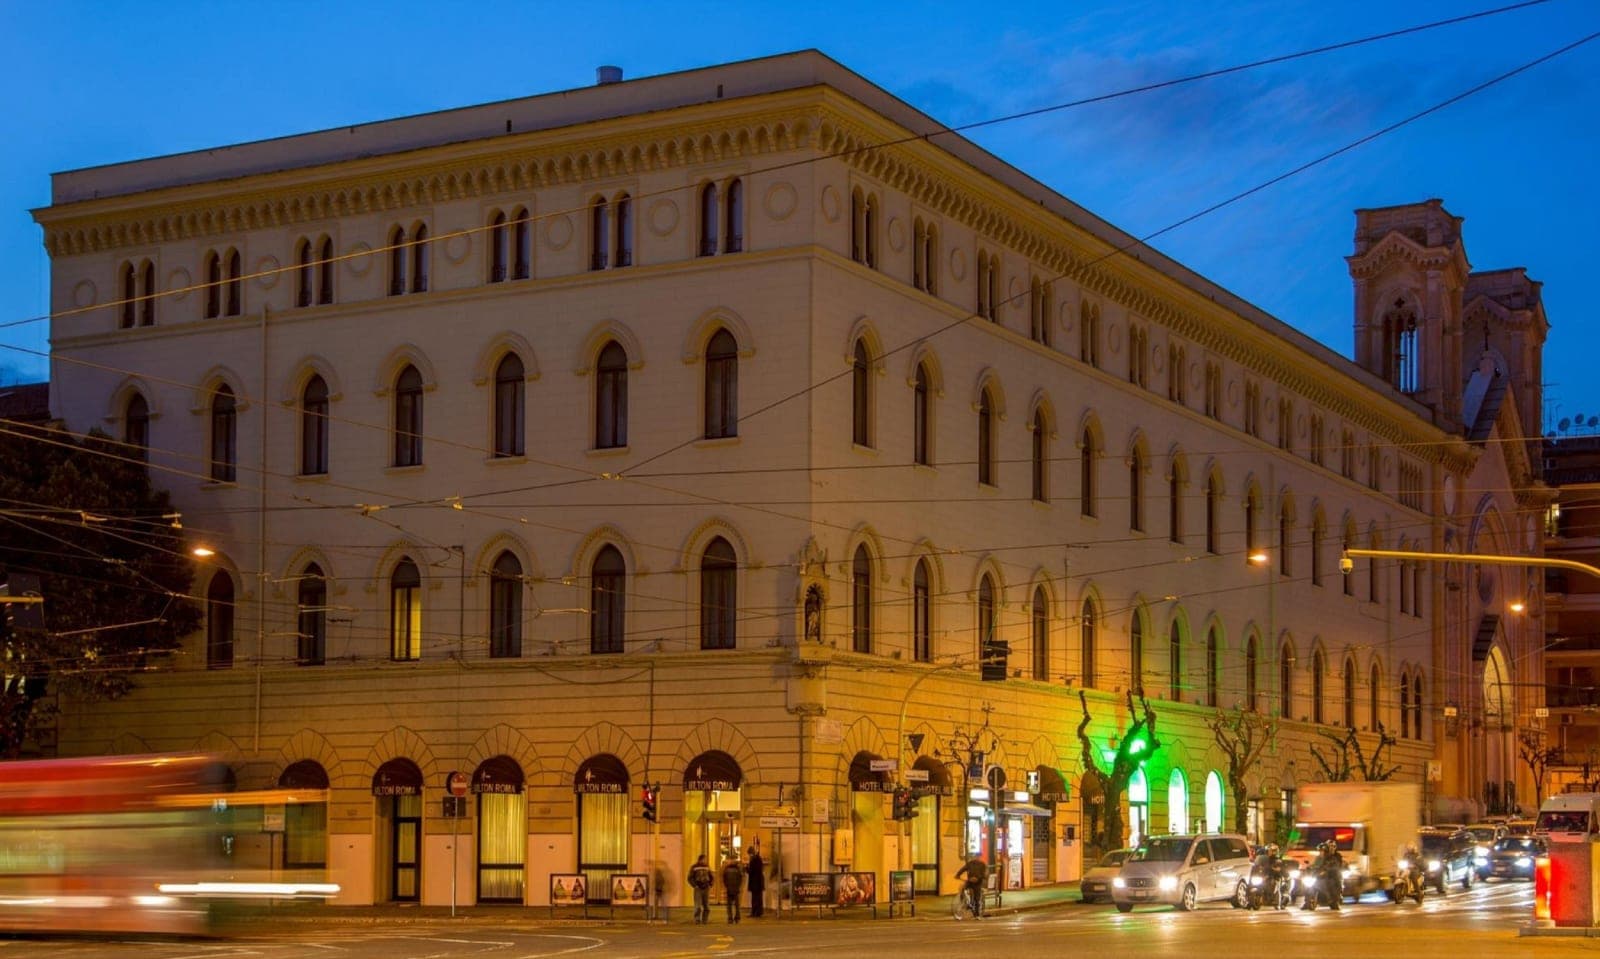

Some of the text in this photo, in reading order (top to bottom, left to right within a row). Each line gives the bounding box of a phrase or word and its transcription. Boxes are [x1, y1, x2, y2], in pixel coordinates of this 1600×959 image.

[495, 784, 516, 793] ROMA
[601, 783, 622, 792] ROMA
[712, 780, 733, 790] ROMA
[859, 782, 881, 791] HOTEL
[395, 786, 416, 796] ROMA
